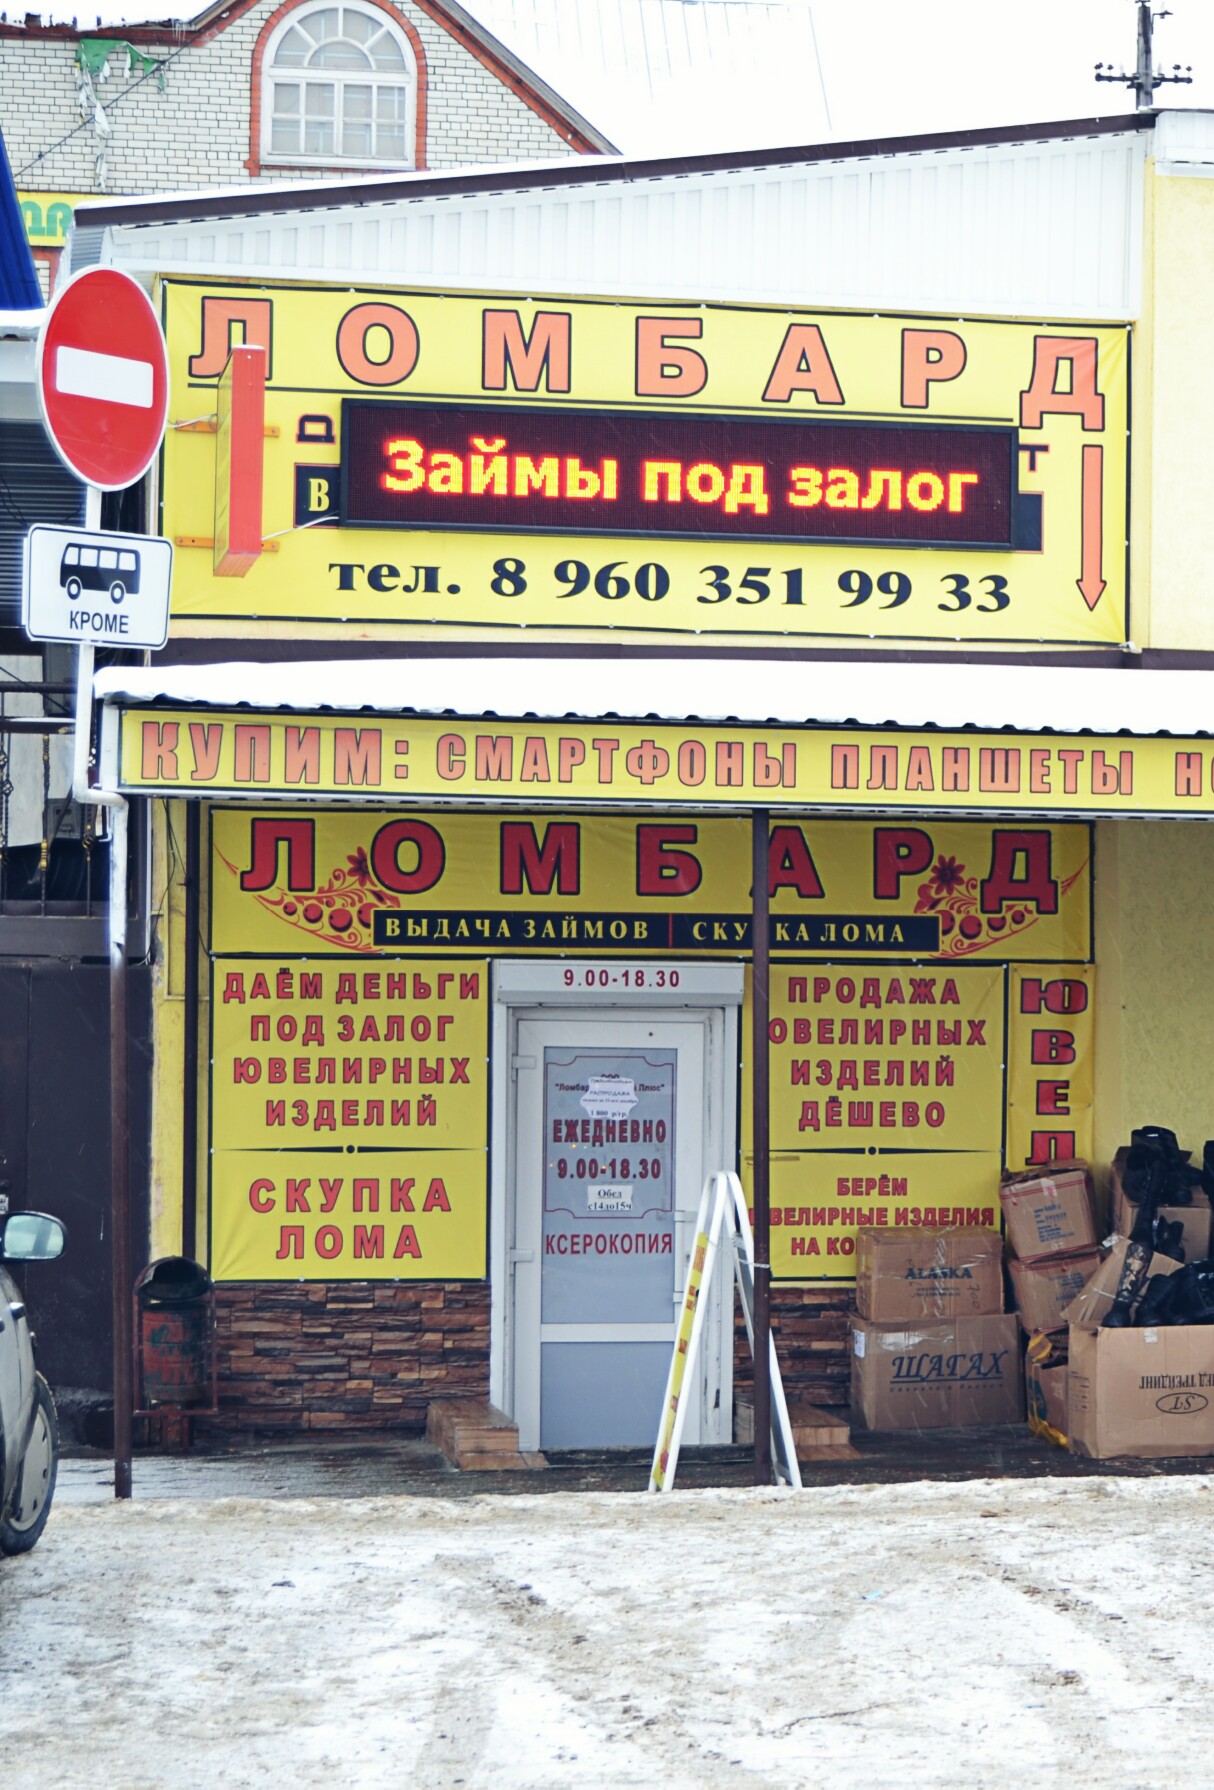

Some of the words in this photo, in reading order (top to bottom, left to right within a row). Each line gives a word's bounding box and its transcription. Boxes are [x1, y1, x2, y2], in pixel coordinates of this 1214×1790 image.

[188, 296, 1105, 432] ЛОМБАРД
[384, 438, 619, 501] Займы
[644, 461, 769, 515] под
[788, 467, 978, 513] залог
[328, 562, 462, 596] тел.
[490, 557, 528, 597] 8
[553, 559, 670, 602] 960
[697, 565, 807, 606] 351
[837, 569, 912, 610] 99
[938, 573, 1011, 613] 33
[69, 610, 129, 634] КРОМЕ
[141, 721, 409, 786] КУПИМ:
[436, 733, 797, 788] СМАРТФОНЫ
[831, 744, 1134, 796] ПЛАНШЕТЫ
[240, 817, 1058, 915] ЛОМБАРД
[385, 917, 511, 941] ВЫДАЧА
[523, 915, 649, 941] ЗАЙМОВ
[692, 920, 811, 943] СКУКА
[820, 922, 906, 944] ЛОМА
[223, 967, 323, 1004] ДАЁМ
[335, 972, 480, 1005] ДЕНЬГИ
[563, 968, 681, 988] 9.00-18.30
[788, 976, 961, 1009] ПРОДАЖА
[251, 1014, 325, 1046] ПОД
[337, 1014, 455, 1042] ЗАЛОГ
[233, 1056, 471, 1084] ЮВЕЛИРНЫХ
[791, 1055, 955, 1091] ИЗДЕЛИЙ
[266, 1093, 437, 1131] ИЗДЕЛИЙ
[798, 1096, 945, 1132] ДЁШЕВО
[553, 1119, 667, 1147] ЕЖЕДНЕВНО
[557, 1158, 661, 1179] 9.00-18.30
[837, 1173, 908, 1196] БЕРЁМ
[249, 1178, 452, 1214] СКУПКА
[748, 1206, 888, 1226] ВЕЛИРНЫЕ
[895, 1207, 994, 1227] ИЗДЕЛИЯ
[276, 1224, 422, 1259] ЛОМА
[546, 1233, 672, 1255] КСЕРОКОПИЯ
[791, 1237, 820, 1256] НА
[904, 1266, 973, 1280] ALASKA
